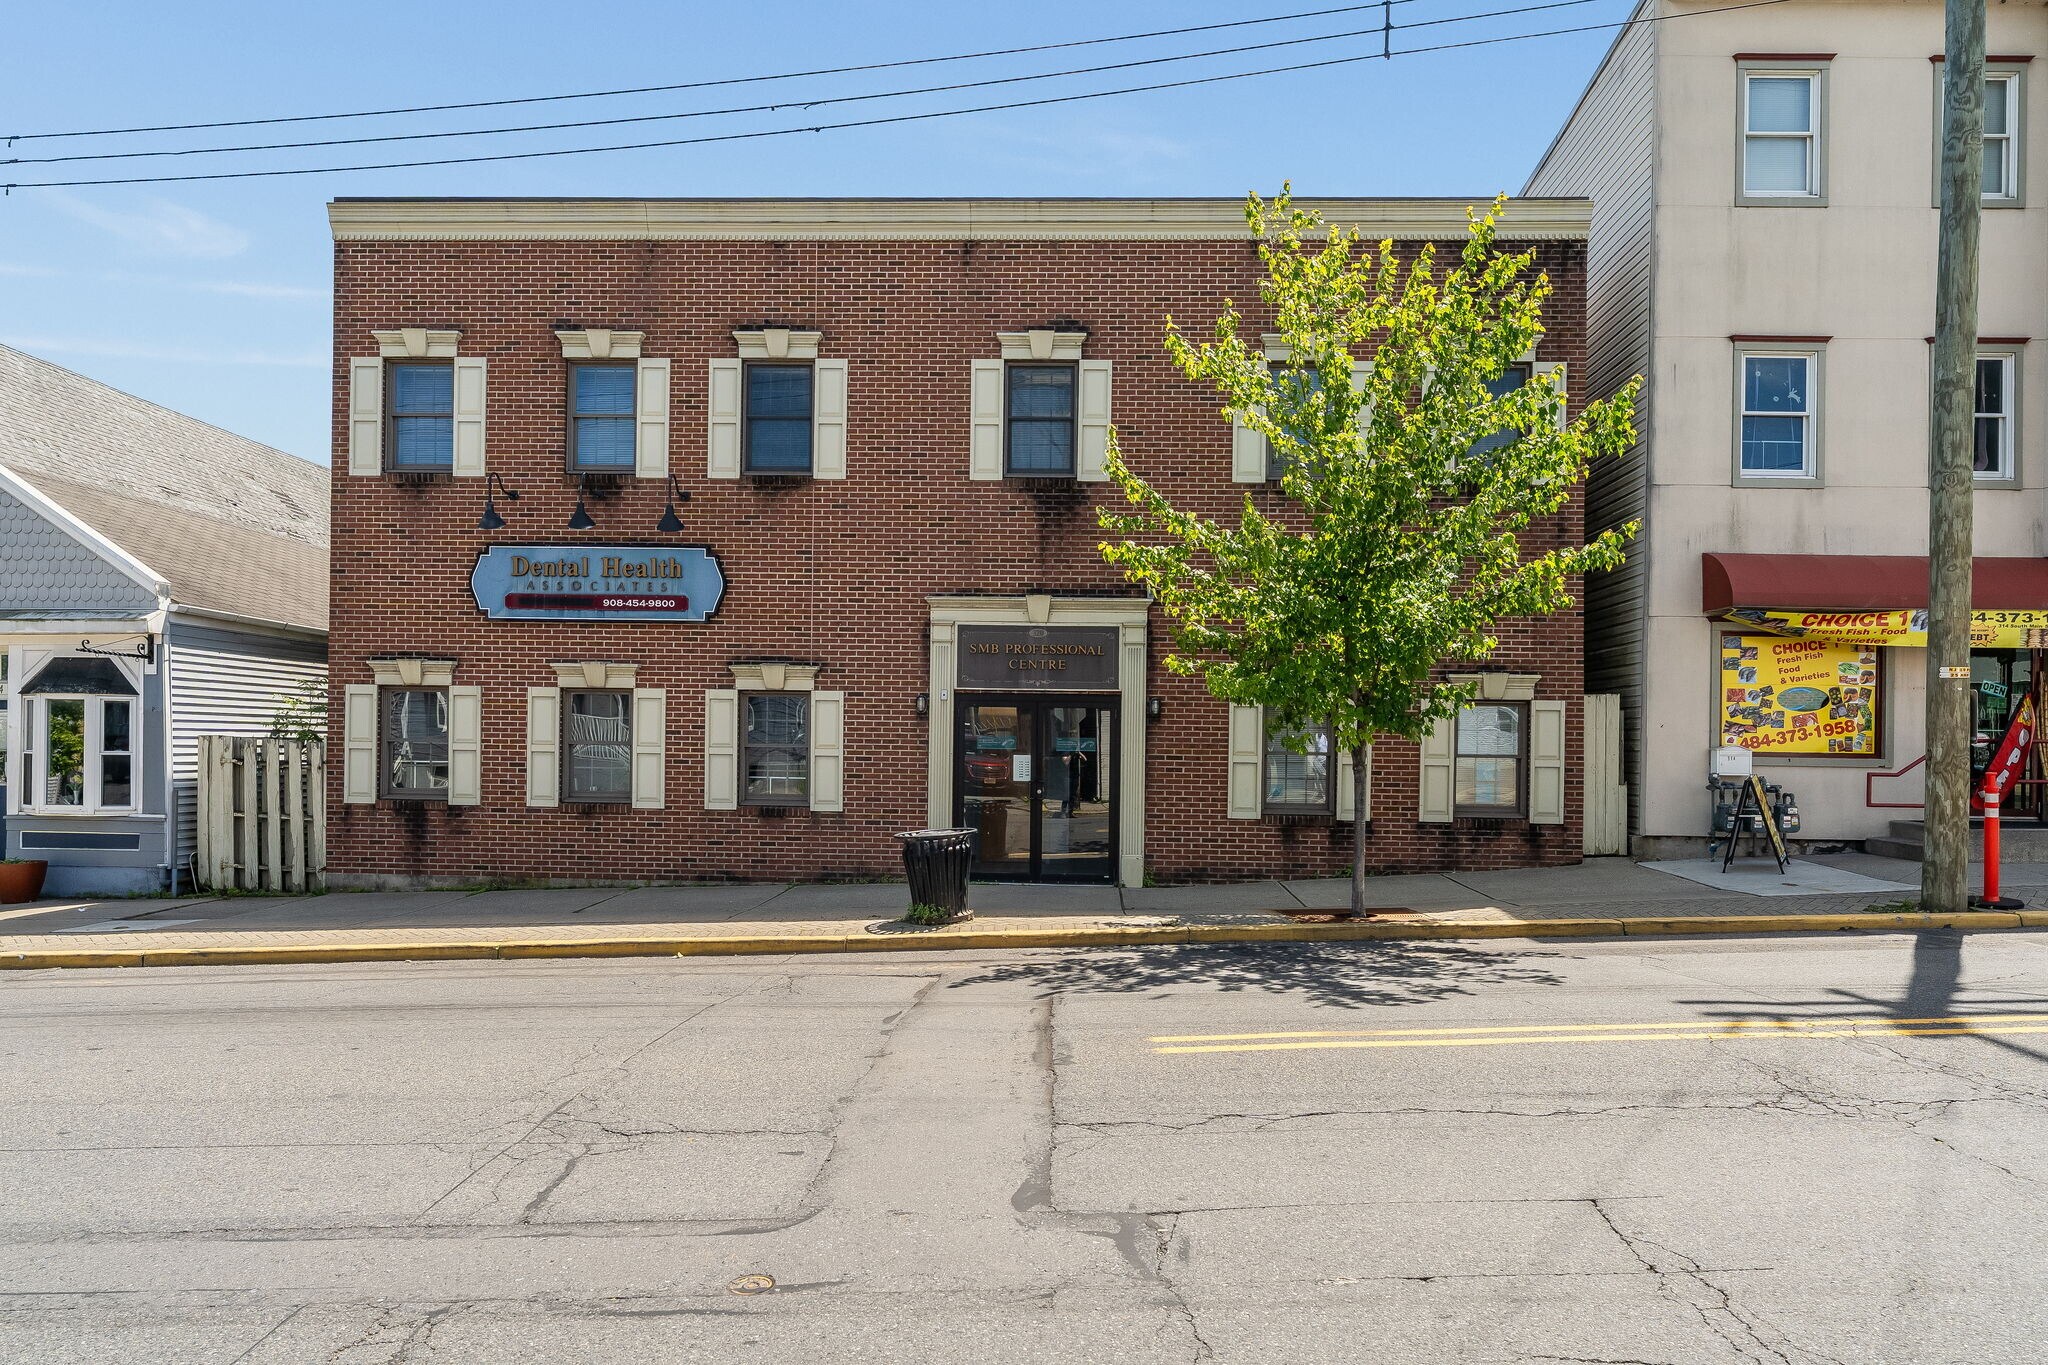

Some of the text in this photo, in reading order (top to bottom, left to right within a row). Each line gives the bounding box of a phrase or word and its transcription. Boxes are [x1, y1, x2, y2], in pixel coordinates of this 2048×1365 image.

[511, 556, 683, 579] Dental Health
[526, 580, 669, 593] ASSOCIATES
[603, 599, 676, 608] 908-454-9800
[1801, 611, 1908, 628] CHOICE 1
[1971, 612, 2048, 623] 4-373-1
[1836, 637, 1888, 645] Varieties
[969, 644, 1105, 657] SMB PROFESSIONAL
[1772, 640, 1827, 655] CHOICE
[1777, 652, 1823, 664] Fresh Fish
[1008, 659, 1067, 670] CENTRE
[1778, 665, 1801, 674] Food
[1789, 671, 1831, 683] Varieties
[1983, 682, 2006, 696] OPEN
[1740, 719, 1856, 749] 484-373-1958
